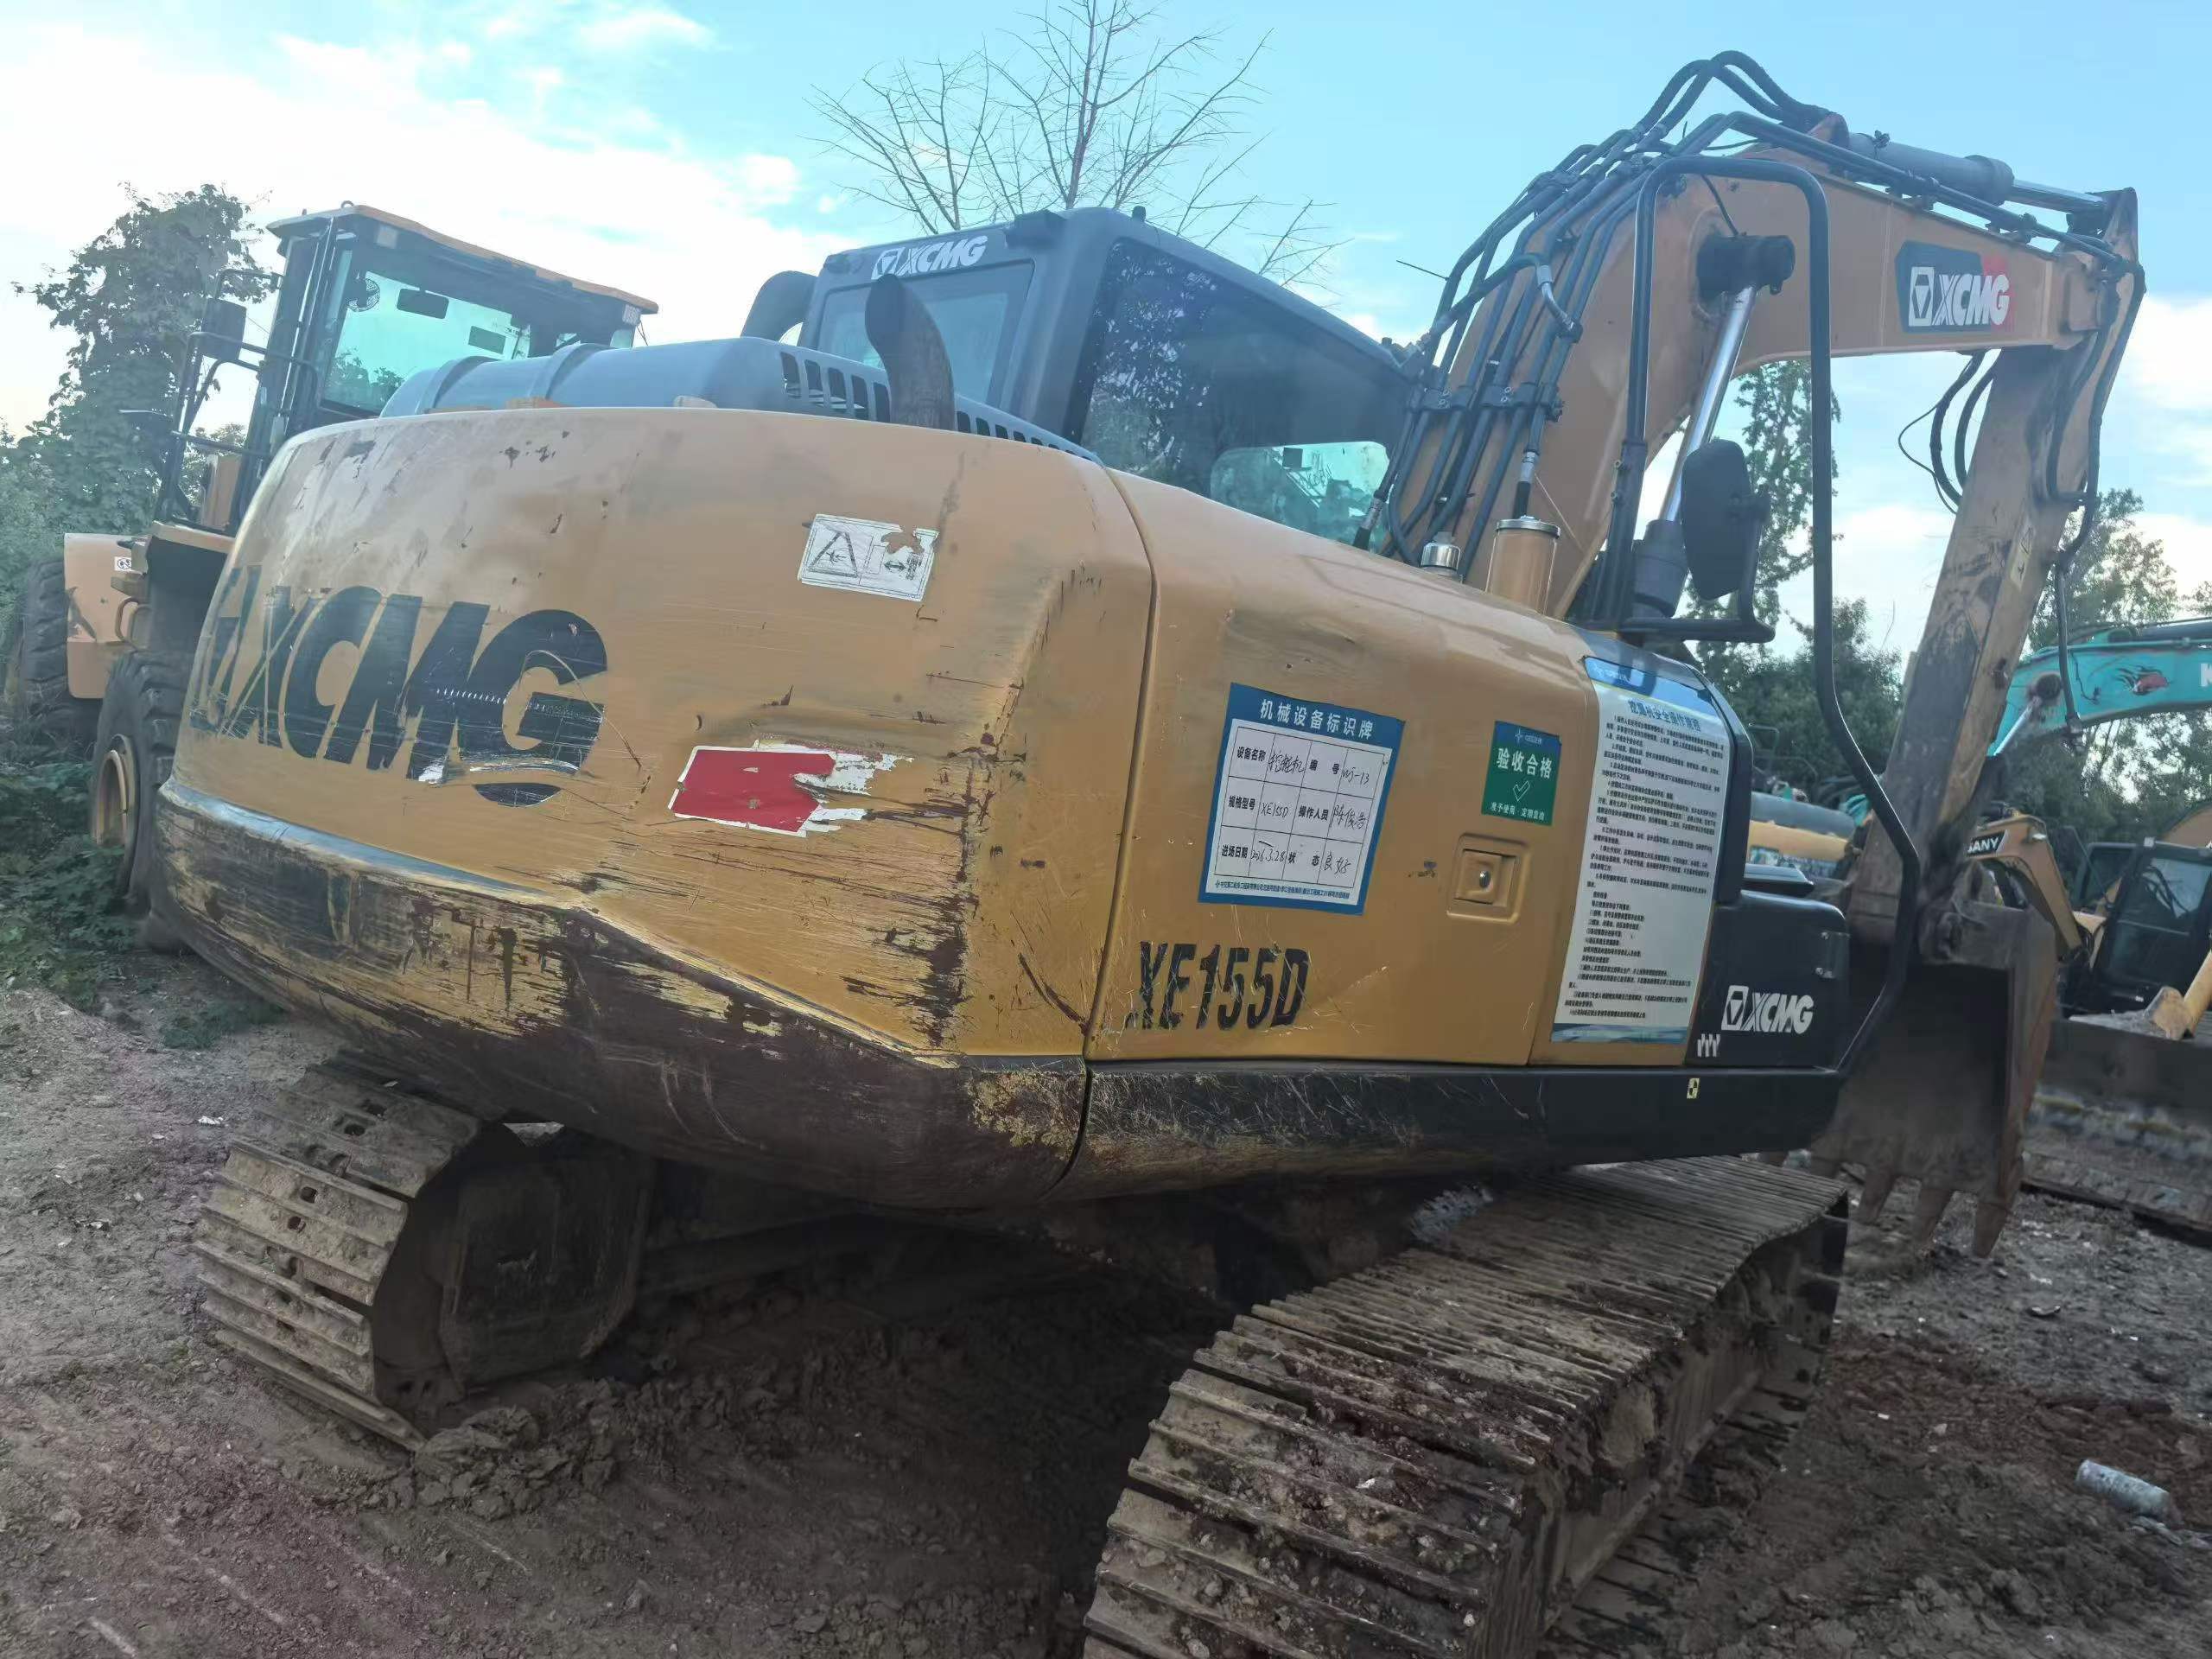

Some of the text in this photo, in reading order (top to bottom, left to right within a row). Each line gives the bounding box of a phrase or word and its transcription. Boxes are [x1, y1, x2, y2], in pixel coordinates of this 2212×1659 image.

[895, 235, 988, 277] XCMG
[1931, 273, 2010, 327] XCMG
[219, 584, 608, 807] XCMG
[1260, 698, 1374, 740] 机械设备标识牌
[1236, 746, 1266, 762] 设备名称
[1496, 747, 1553, 779] 验收合格
[1228, 795, 1255, 811] 规格型号
[1298, 804, 1329, 821] 操作人员
[1221, 844, 1248, 860] 进场日期
[1123, 940, 1310, 1031] XE155D
[1740, 992, 1815, 1035] XCMG
